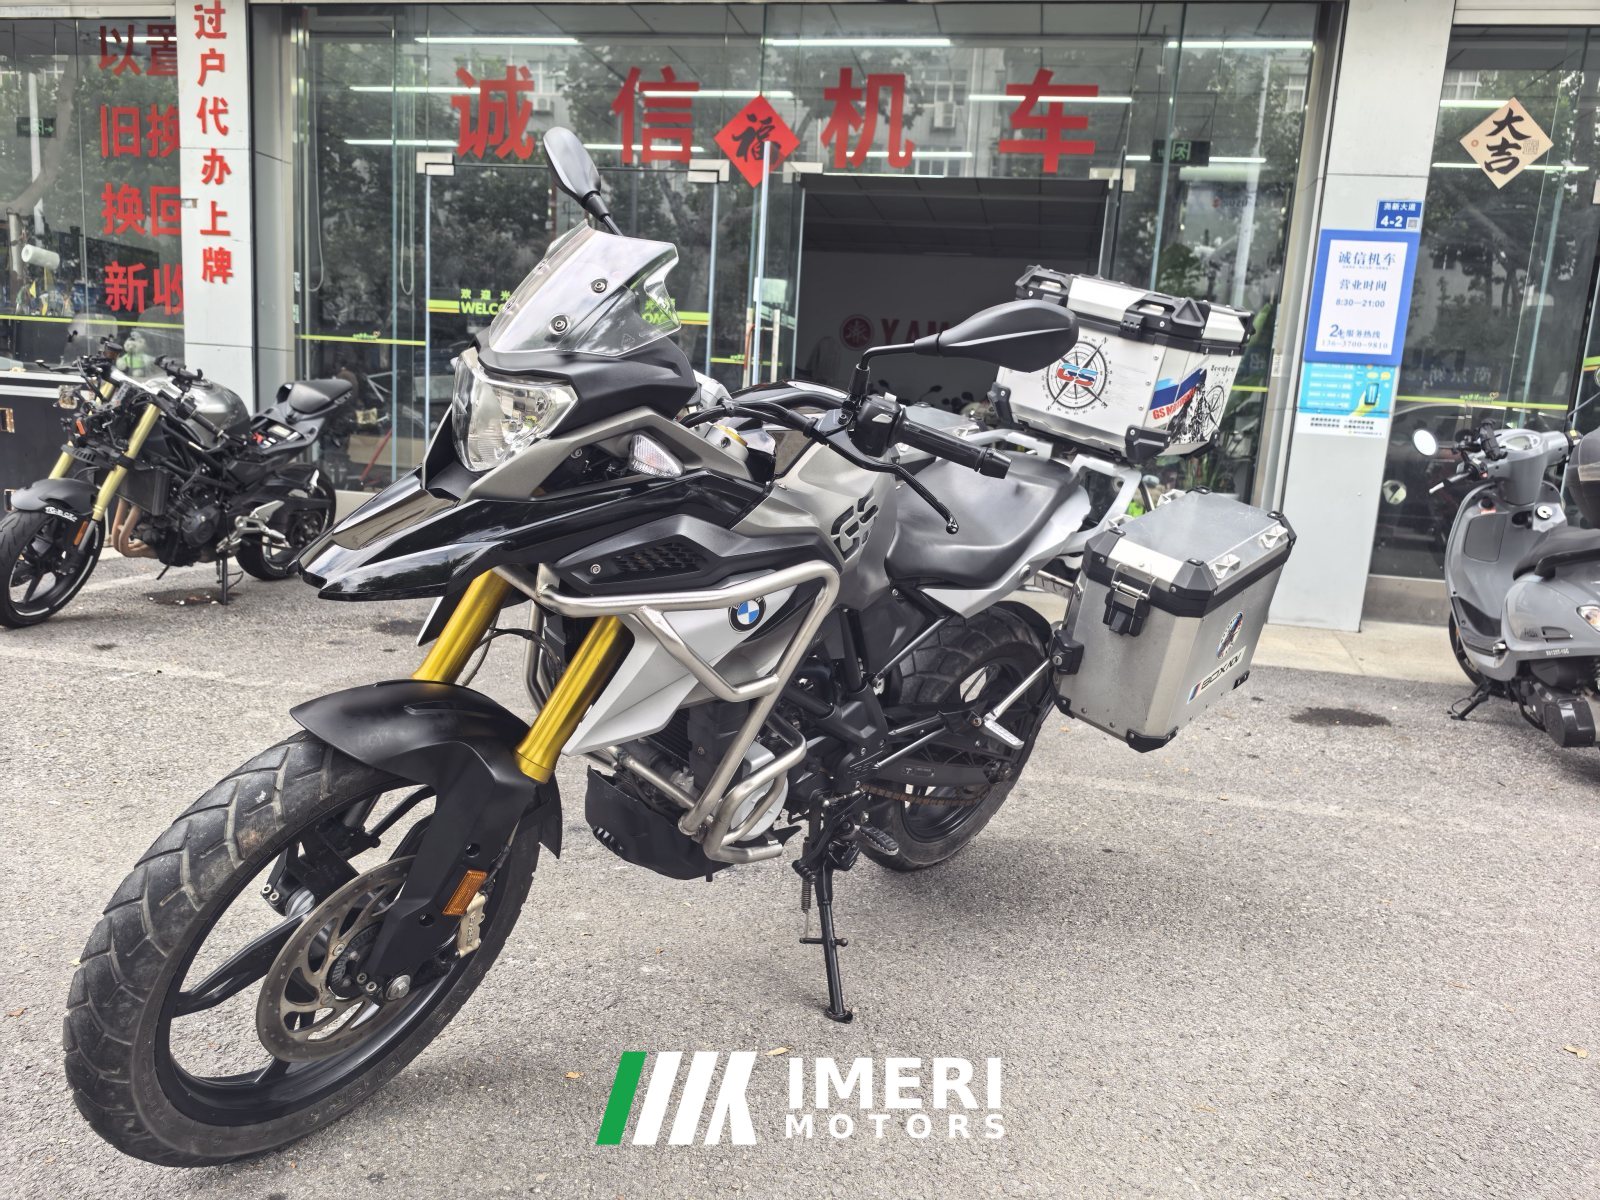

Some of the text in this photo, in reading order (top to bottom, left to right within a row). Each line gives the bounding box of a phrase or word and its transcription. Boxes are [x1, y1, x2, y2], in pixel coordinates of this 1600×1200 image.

[194, 1, 234, 284] 过户代办上牌
[452, 65, 1099, 173] 诚信机车
[732, 113, 782, 163] 福
[1484, 107, 1532, 175] 大吉
[99, 24, 148, 313] 以旧换新
[1380, 215, 1403, 228] 4-2
[1338, 251, 1397, 267] 诚信机车
[1339, 279, 1388, 292] 营业时间
